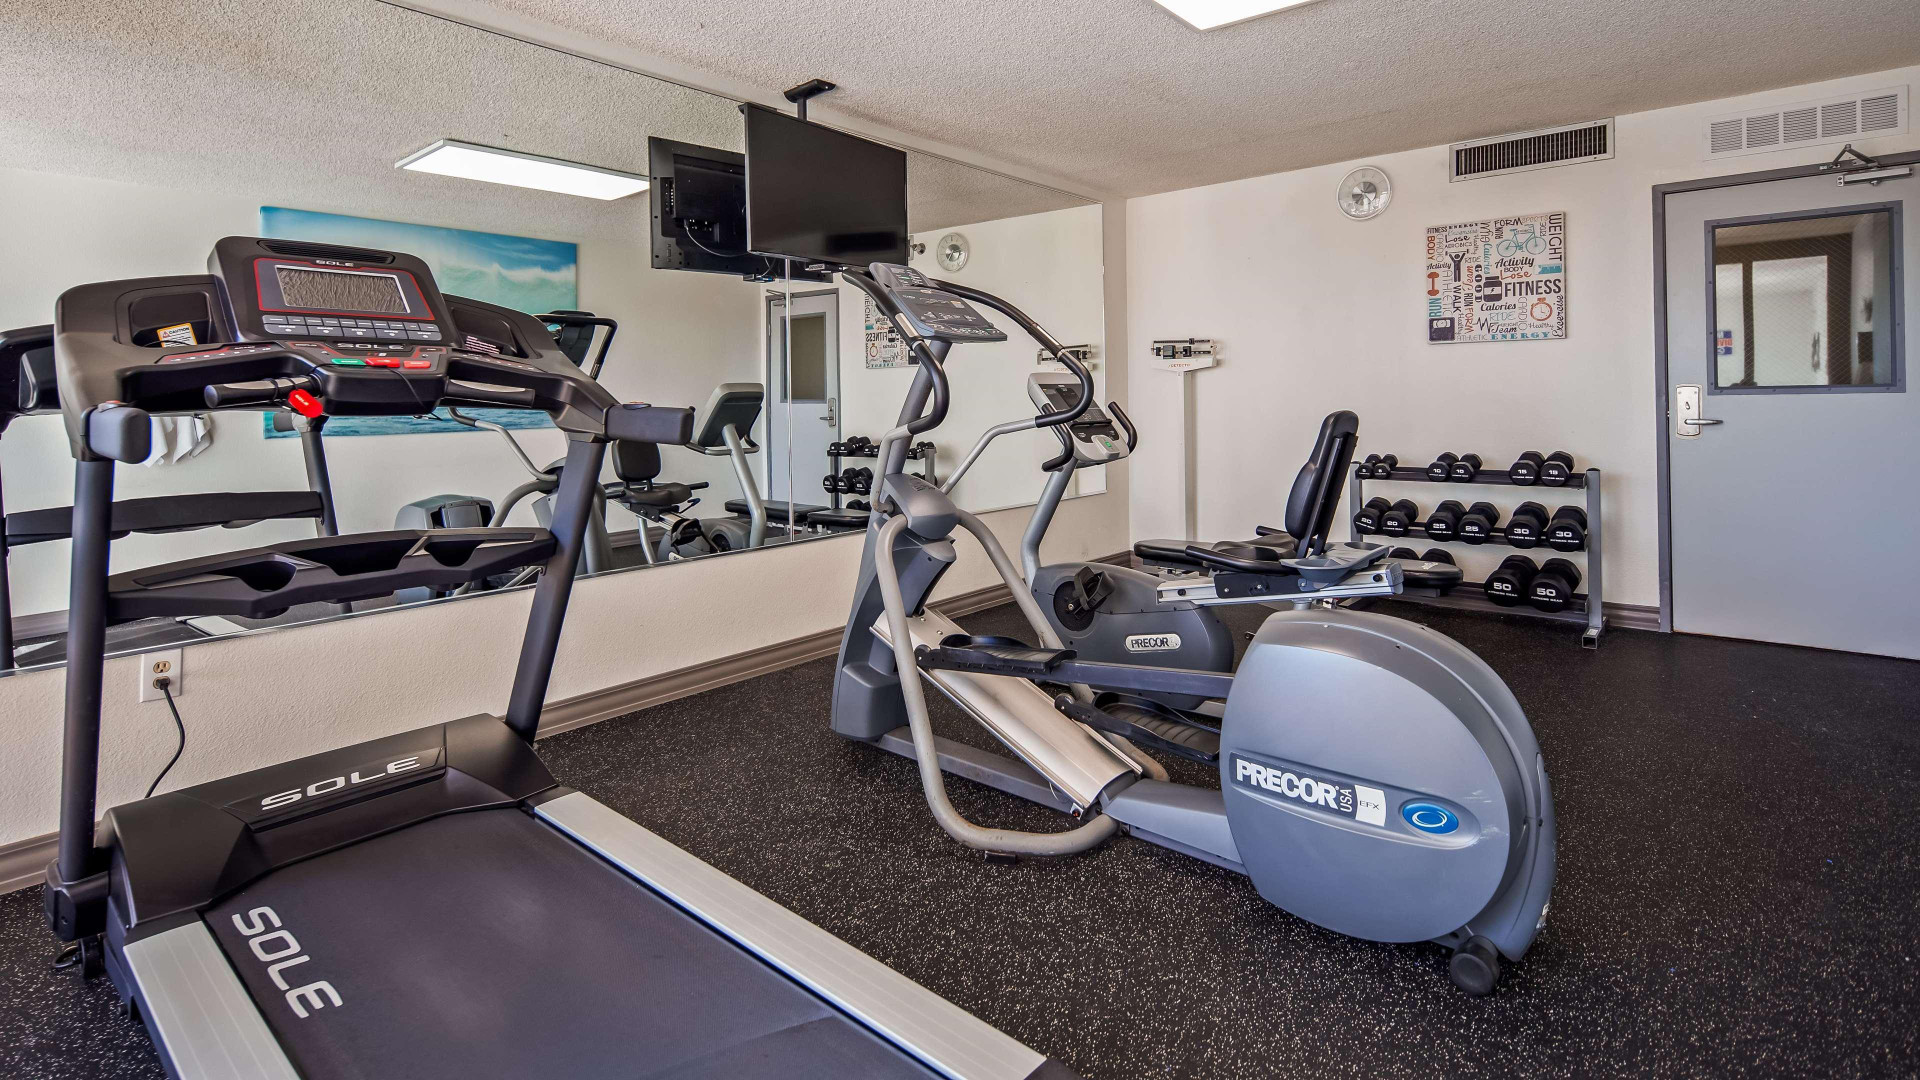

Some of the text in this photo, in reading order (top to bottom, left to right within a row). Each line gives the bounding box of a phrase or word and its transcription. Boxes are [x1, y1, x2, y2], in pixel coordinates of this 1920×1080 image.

[1449, 222, 1479, 230] ENERGY
[1494, 217, 1523, 227] FORM
[1427, 226, 1447, 234] FITNESS
[1445, 235, 1470, 243] Lose
[1549, 213, 1562, 262] WEIGHT
[1427, 235, 1436, 261] BODY
[316, 259, 354, 267] SOLE
[1465, 256, 1482, 264] RIDE
[1483, 243, 1493, 275] Calories
[1495, 256, 1535, 268] Activity
[1426, 262, 1452, 271] Activity
[1500, 270, 1532, 280] Lose
[1475, 264, 1483, 303] GOOD
[1504, 279, 1562, 297] FITNESS
[1442, 270, 1453, 317] ATHLETIC
[1453, 284, 1462, 313] WALK
[1464, 293, 1474, 307] RUN
[1429, 298, 1442, 317] RUN
[1480, 302, 1517, 312] Calories
[1489, 311, 1517, 322] RIDE
[1518, 296, 1528, 331] CARDIO
[1552, 295, 1564, 338] Exercise
[1465, 307, 1475, 335] FORM
[1490, 323, 1518, 334] Team
[1491, 332, 1550, 341] ENERGY
[1493, 582, 1512, 591] 50
[1536, 587, 1556, 597] 50
[1130, 637, 1170, 648] PRECOR
[261, 756, 421, 811] SOLE
[1236, 758, 1380, 813] PRECOR USA EFX
[231, 906, 344, 1019] SOLE
